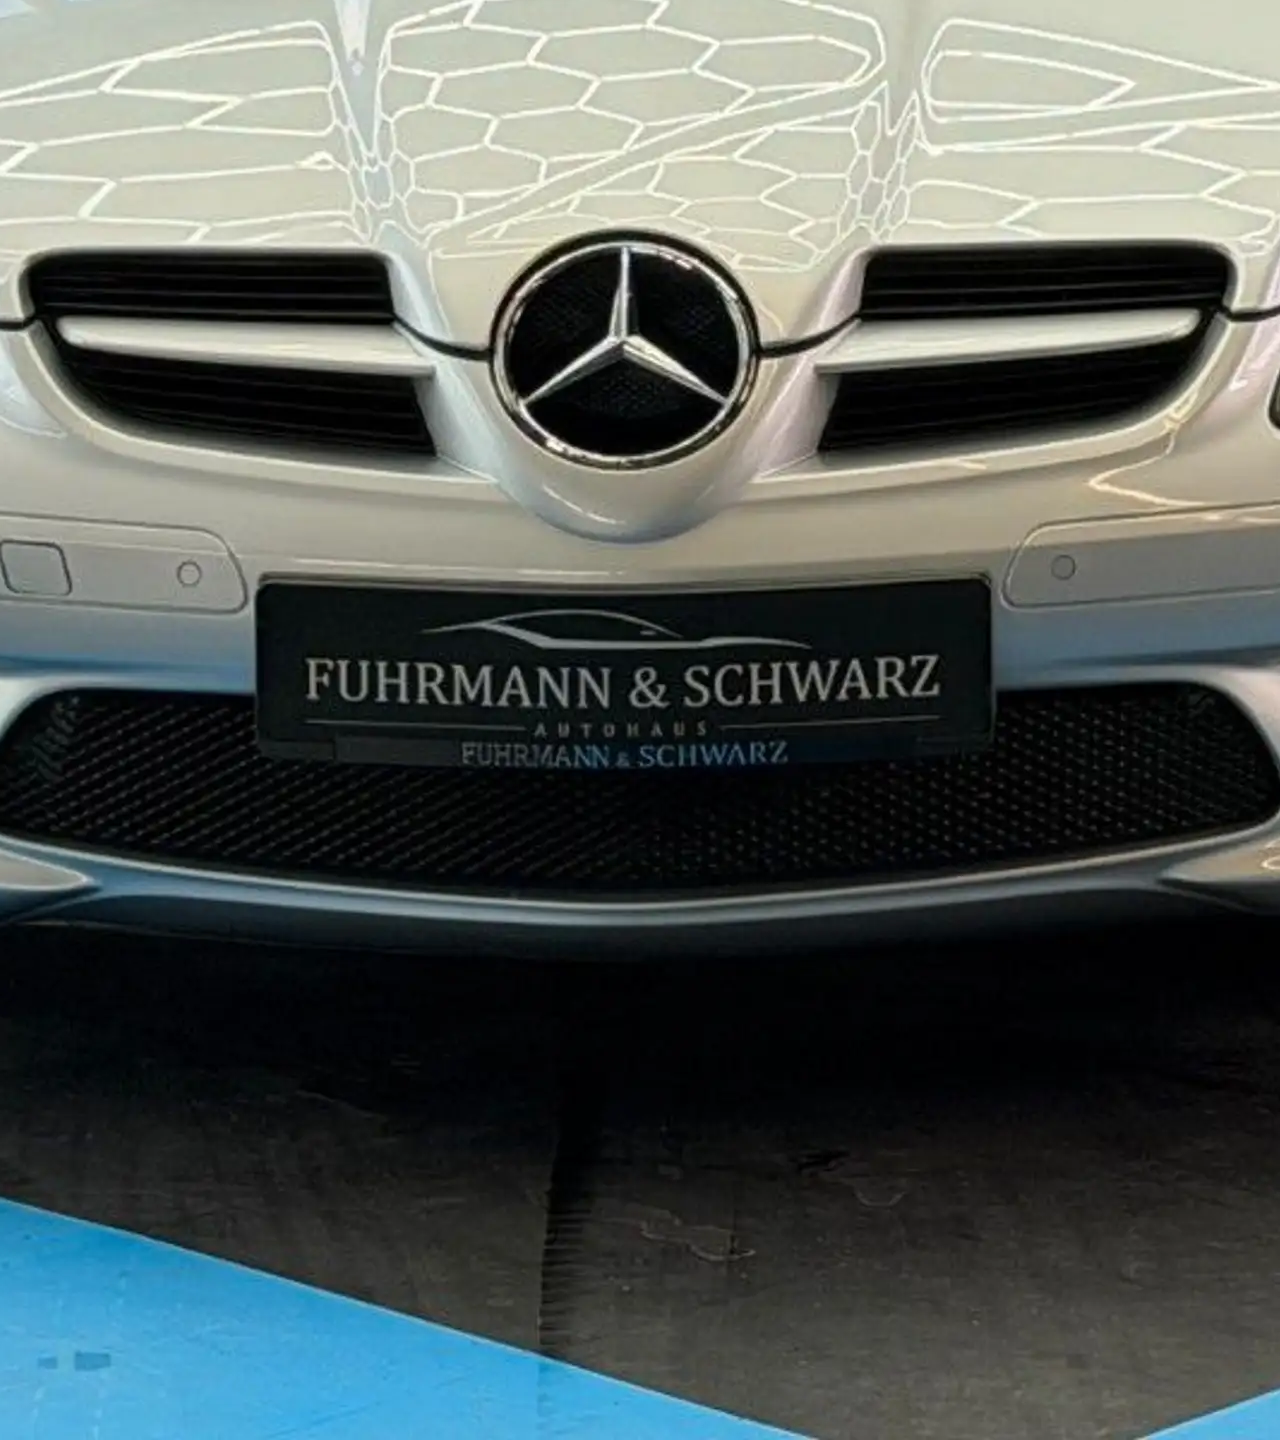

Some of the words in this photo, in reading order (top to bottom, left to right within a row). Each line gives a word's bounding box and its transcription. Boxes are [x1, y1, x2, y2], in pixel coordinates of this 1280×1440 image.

[305, 657, 612, 709] FUHRMANN
[628, 666, 670, 709] &
[683, 654, 941, 707] SCHWARZ
[534, 720, 707, 738] AUTOHAUS
[461, 741, 610, 768] FUHRMANN
[638, 740, 789, 768] SCHWARZ
